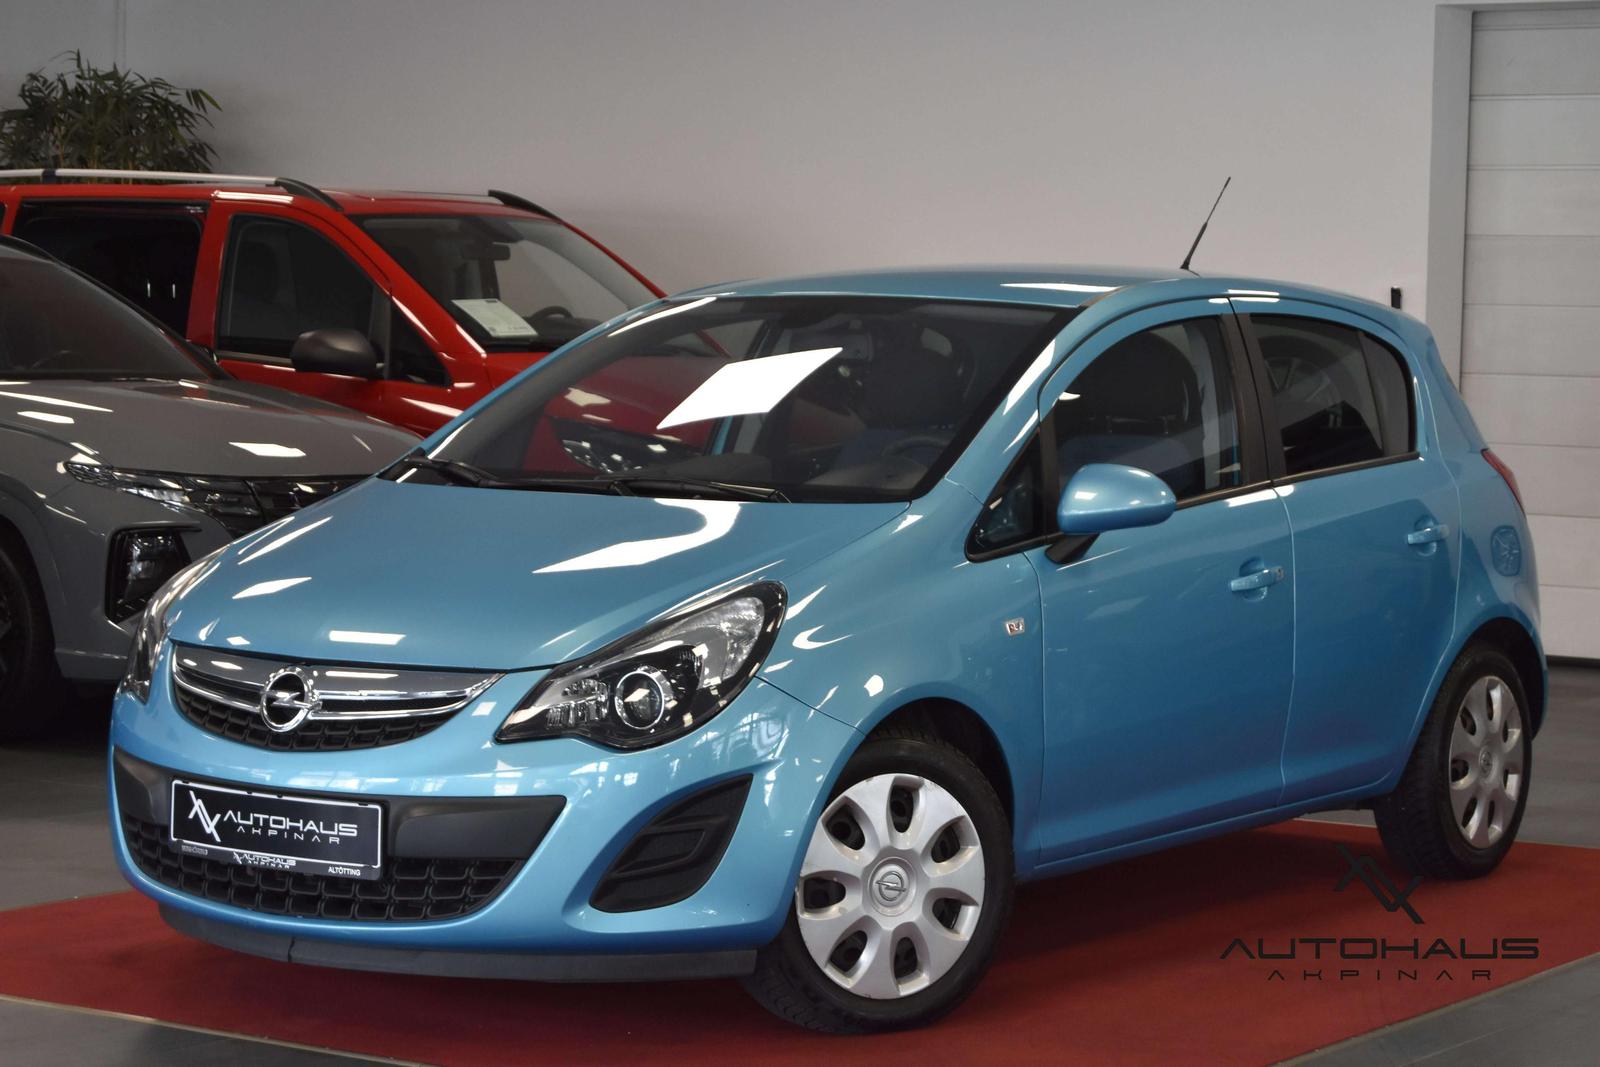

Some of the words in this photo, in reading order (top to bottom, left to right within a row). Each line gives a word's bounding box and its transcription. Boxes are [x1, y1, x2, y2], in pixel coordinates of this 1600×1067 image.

[224, 810, 358, 837] AUTOHAUS
[236, 826, 340, 845] AKPINAR
[242, 853, 296, 867] AUTOHAUS
